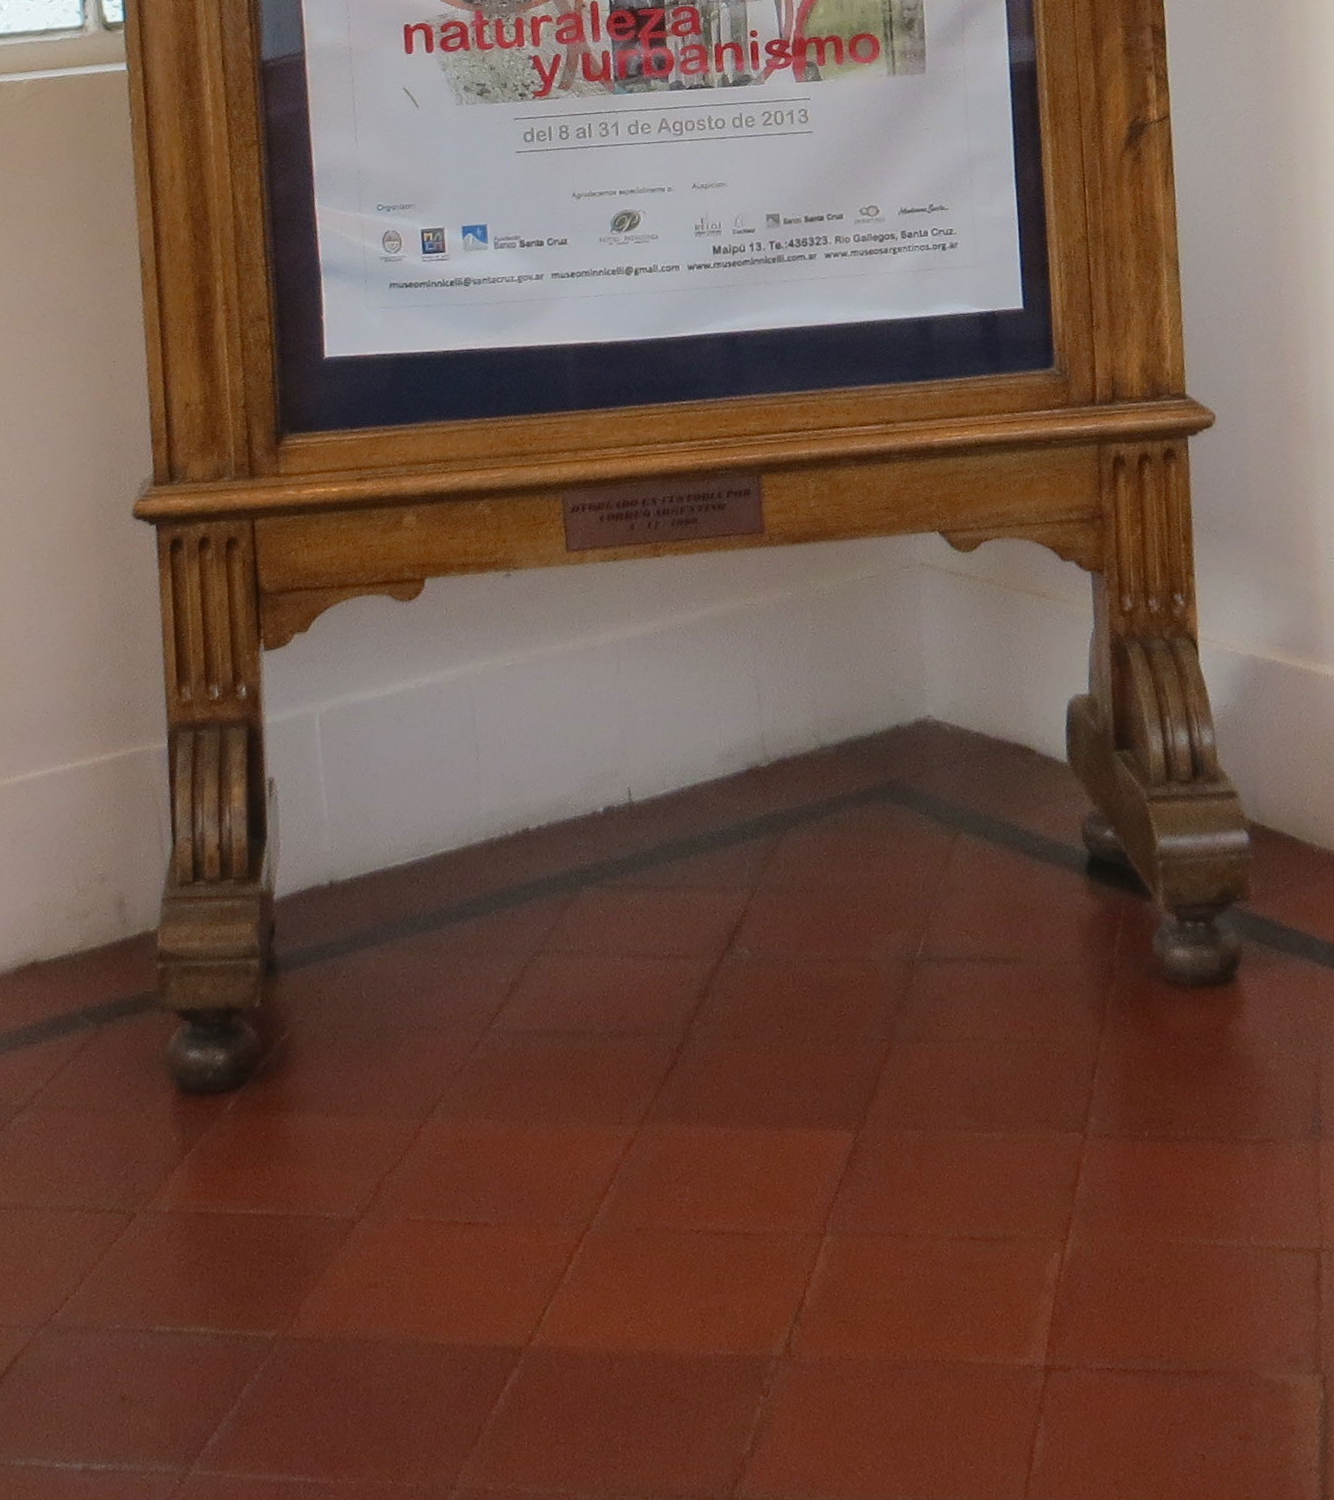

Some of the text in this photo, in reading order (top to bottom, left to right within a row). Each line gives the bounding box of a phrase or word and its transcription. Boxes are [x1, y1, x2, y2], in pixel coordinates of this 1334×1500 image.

[402, 0, 703, 55] naturaleza
[532, 29, 882, 97] y urbanismo
[523, 108, 809, 143] del 8 al 31 de Agosto de 2013
[494, 237, 568, 250] Banco Santa Cruz
[901, 229, 929, 240] Santa
